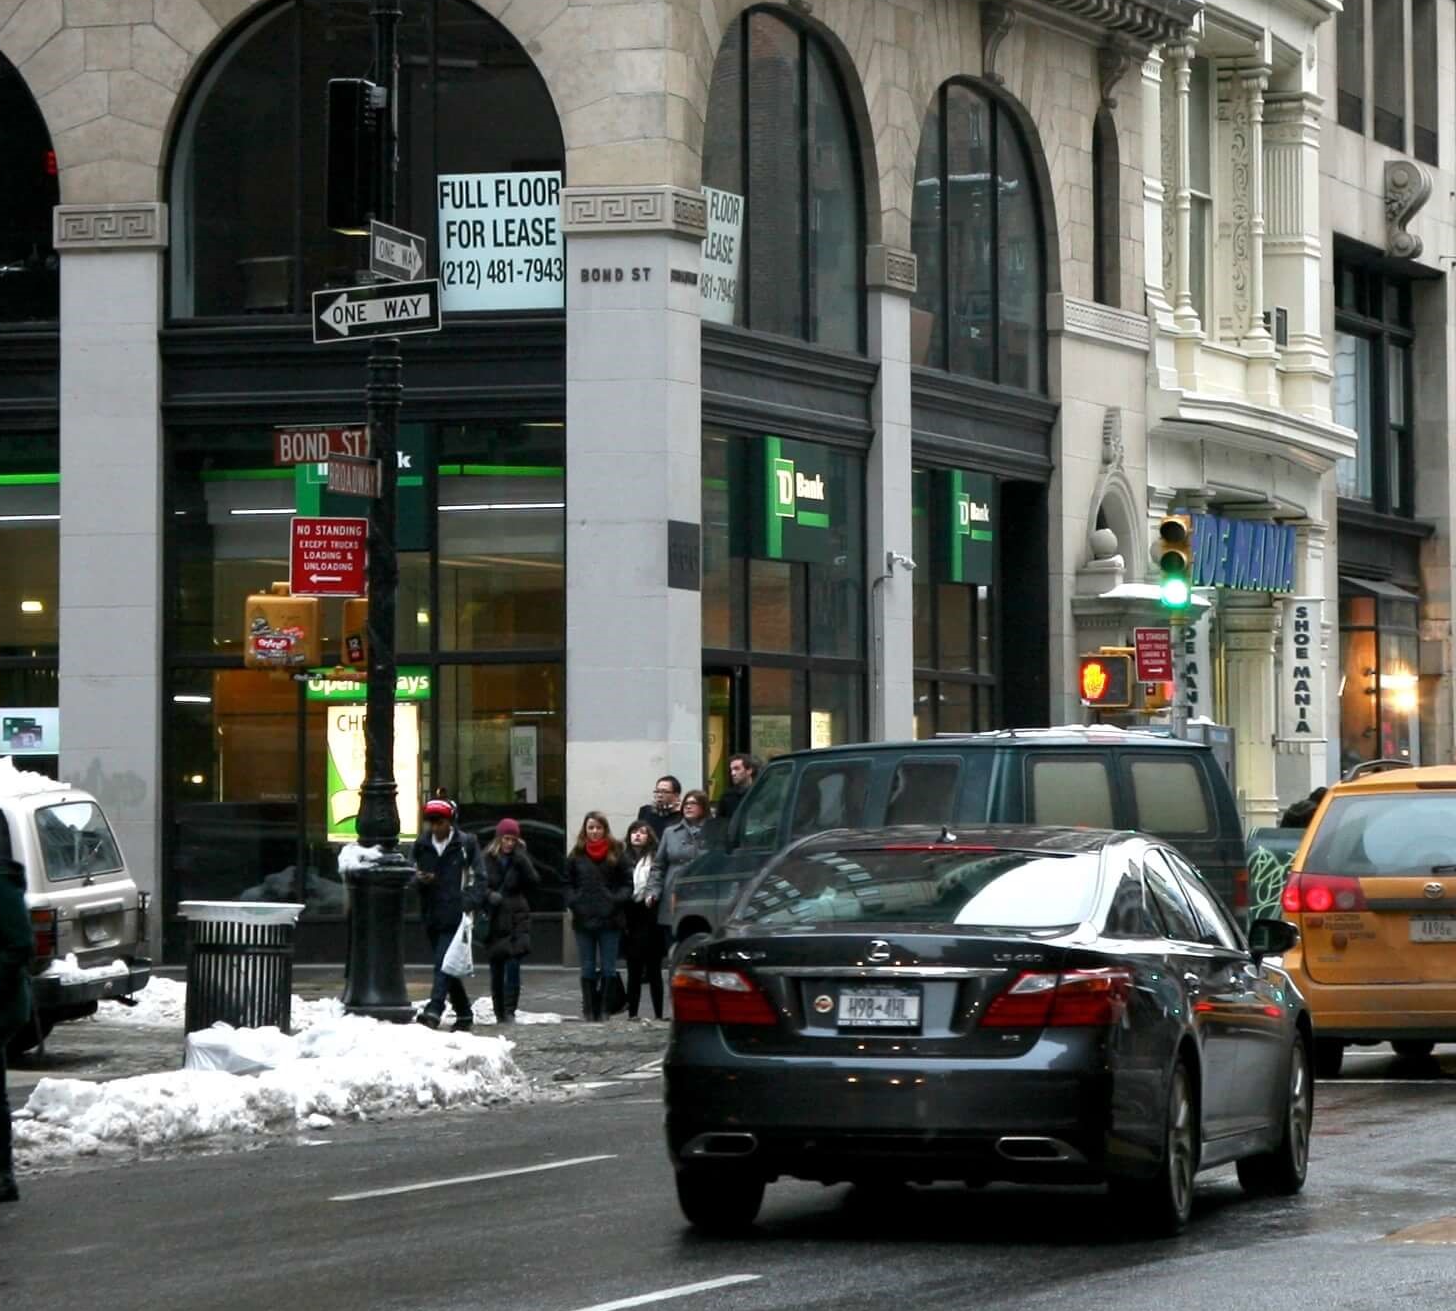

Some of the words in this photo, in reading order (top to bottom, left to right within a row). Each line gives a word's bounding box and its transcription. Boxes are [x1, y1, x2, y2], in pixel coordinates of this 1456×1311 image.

[439, 179, 488, 209] FULL
[495, 177, 560, 208] FLOOR
[710, 192, 740, 226] FLOOR
[446, 220, 485, 249] FOR
[493, 217, 556, 248] LEASE
[705, 232, 734, 265] LEASE
[379, 241, 394, 263] ONE
[402, 247, 419, 270] WAY
[440, 259, 481, 291] (212)
[486, 257, 563, 285] 481-7943
[581, 267, 624, 283] BOND
[632, 267, 651, 282] ST
[333, 303, 367, 324] ONE
[384, 297, 422, 319] WAY
[280, 433, 330, 462] BOND
[341, 431, 363, 458] ST
[329, 460, 377, 495] BROADWAY
[776, 469, 793, 505] TD
[796, 472, 825, 502] Bank
[970, 501, 990, 522] Bank
[297, 525, 310, 536] NO
[315, 525, 362, 537] STANDING
[299, 541, 327, 549] EXCEPT
[330, 541, 359, 549] TRUCKS
[303, 551, 341, 560] LOADING
[303, 563, 353, 571] UNLOADING
[1294, 607, 1310, 659] SHOE
[308, 677, 360, 695] Open
[1293, 666, 1311, 733] MANIA
